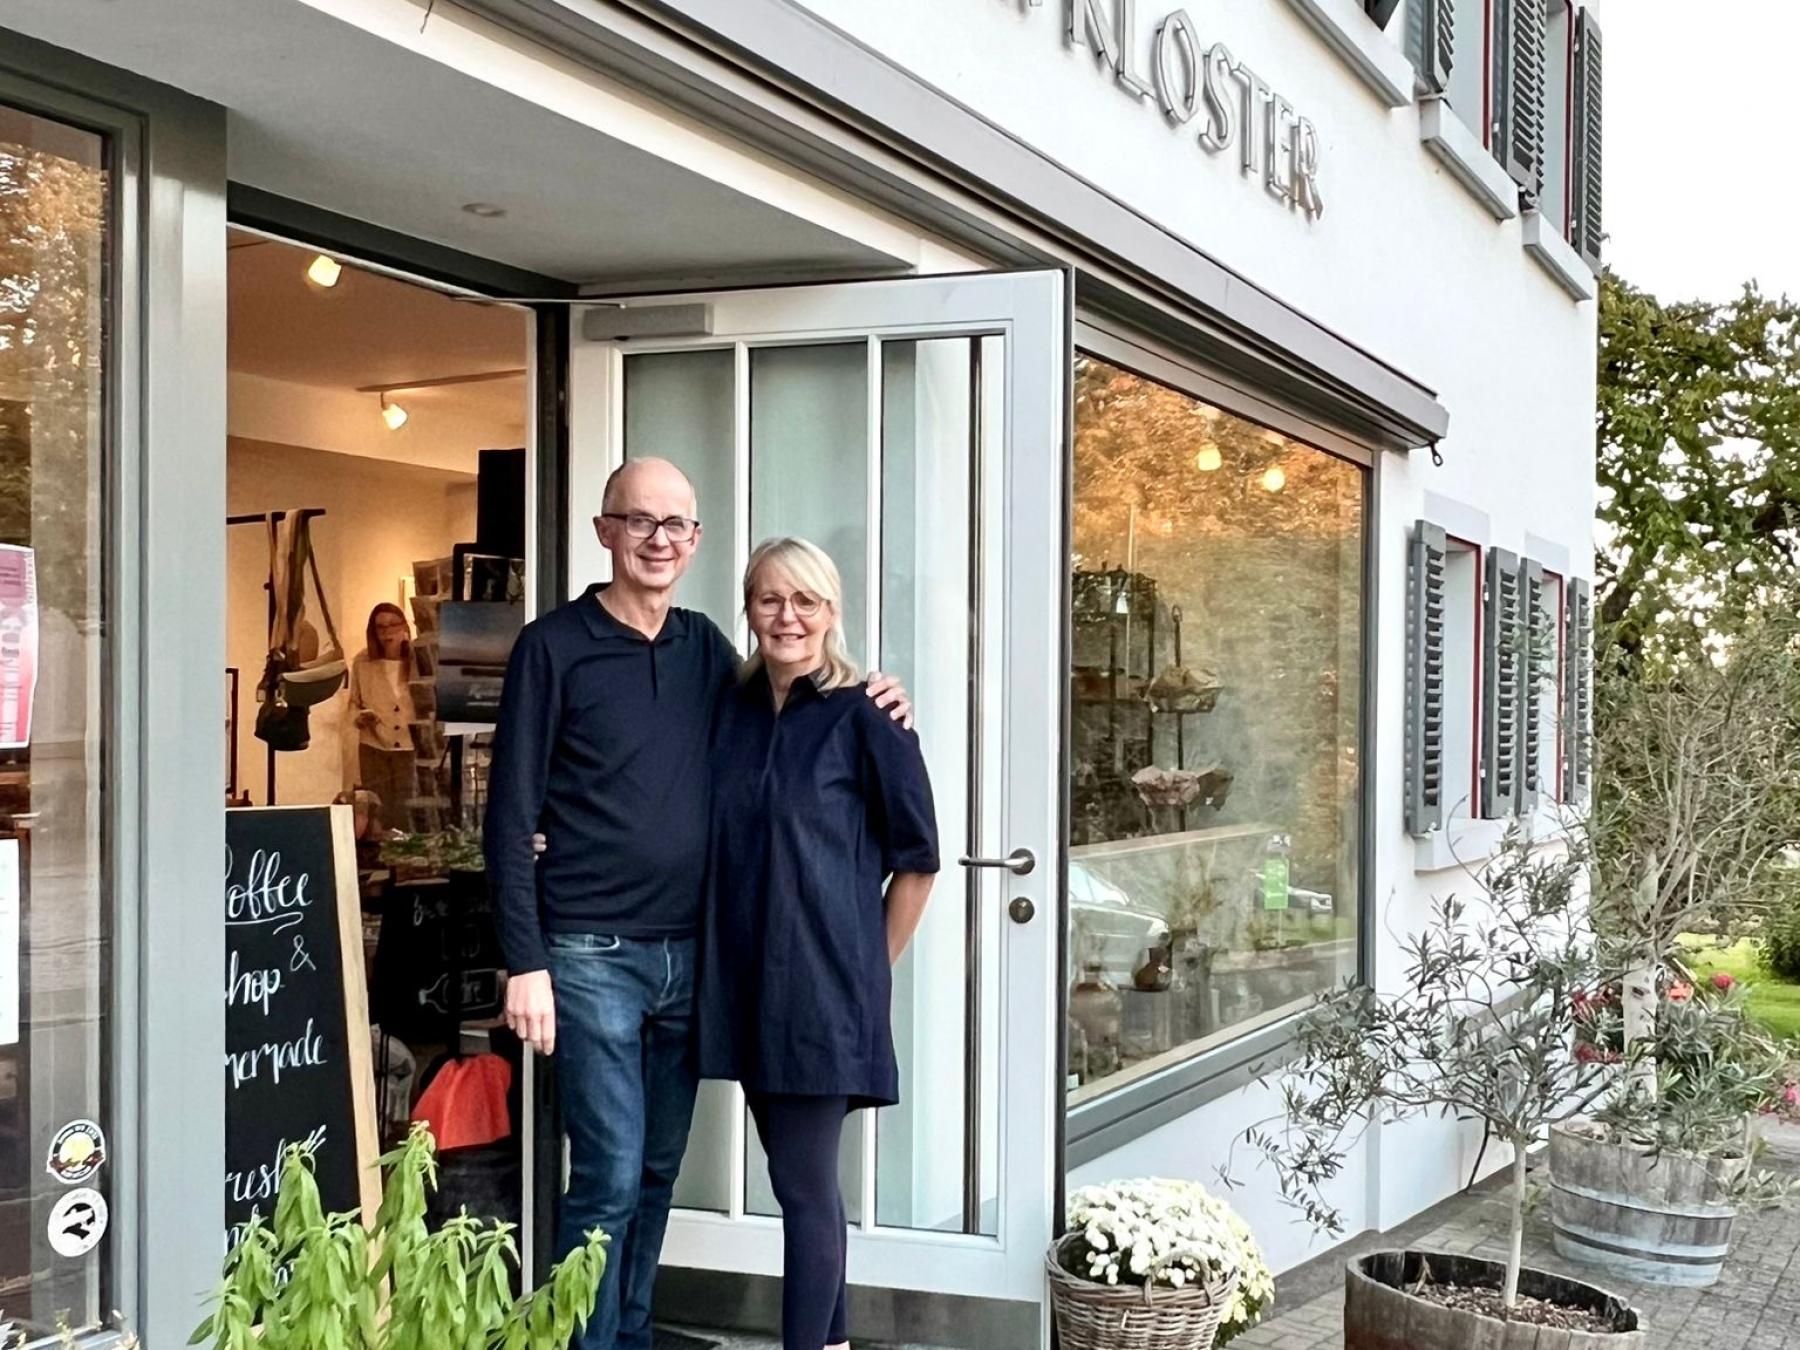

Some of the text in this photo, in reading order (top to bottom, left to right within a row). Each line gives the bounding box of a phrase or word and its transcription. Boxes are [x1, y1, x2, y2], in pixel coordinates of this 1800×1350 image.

[225, 844, 312, 918] offee
[225, 935, 317, 1016] hop &
